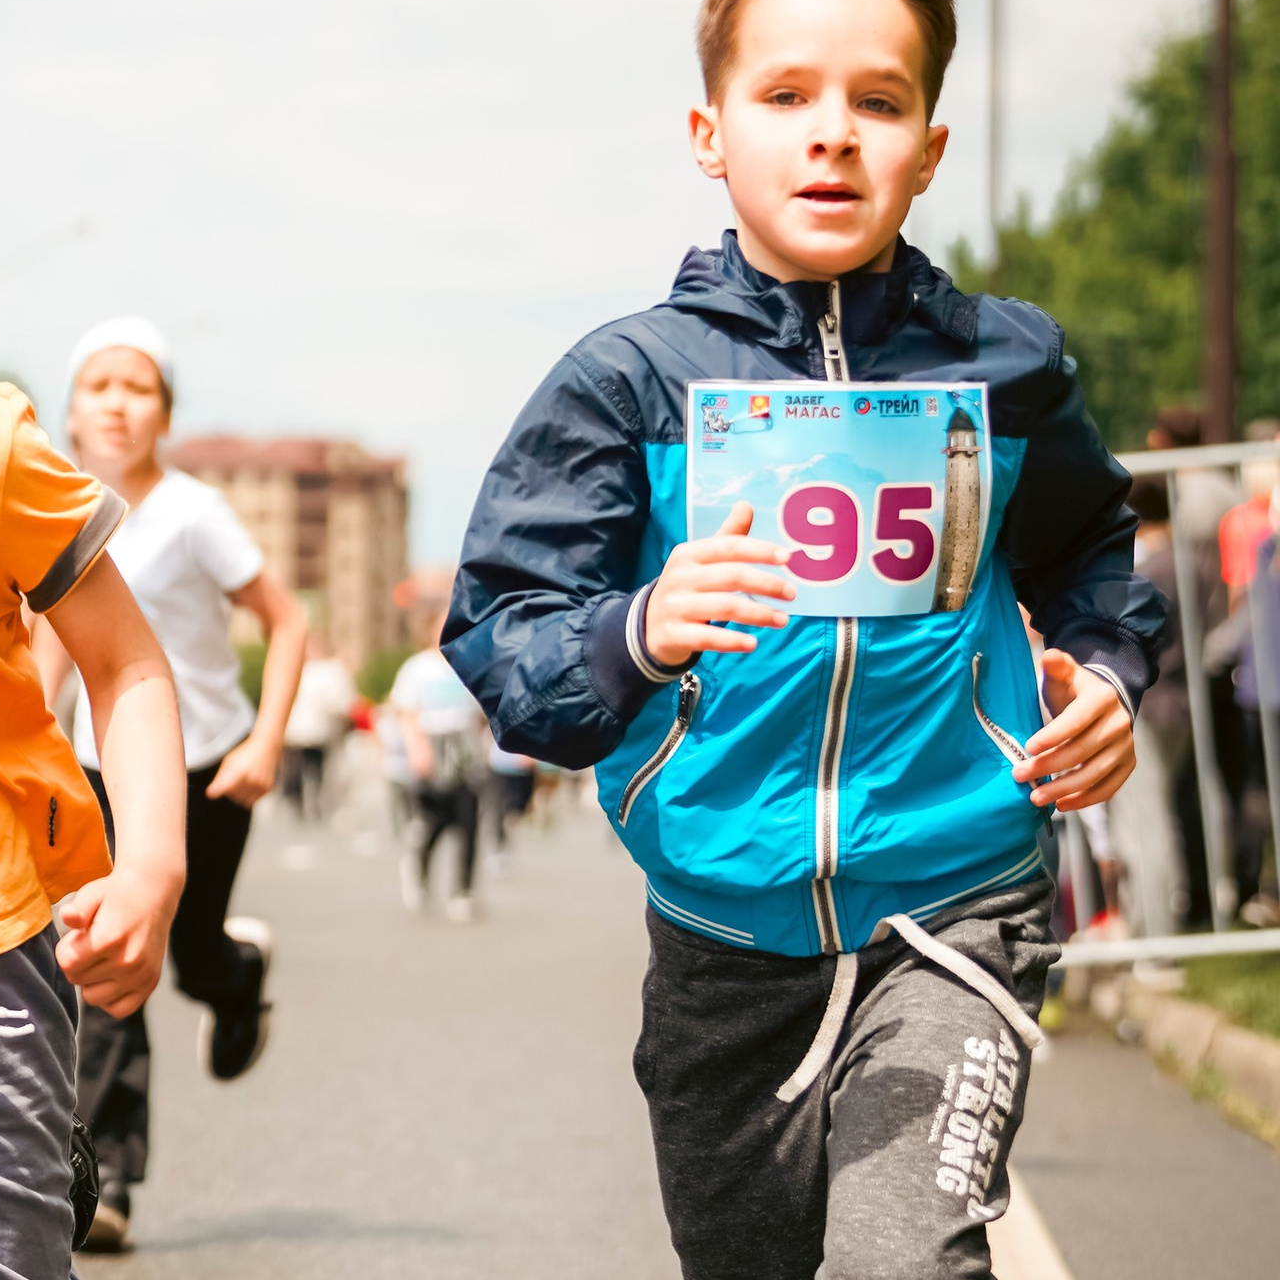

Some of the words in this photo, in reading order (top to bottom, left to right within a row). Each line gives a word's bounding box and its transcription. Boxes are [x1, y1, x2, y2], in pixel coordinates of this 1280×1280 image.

[702, 397, 729, 407] 2026
[784, 395, 824, 405] ЗАБЕГ
[784, 406, 841, 419] МАГАС
[782, 485, 935, 582] 95
[936, 1036, 997, 1197] STRONG
